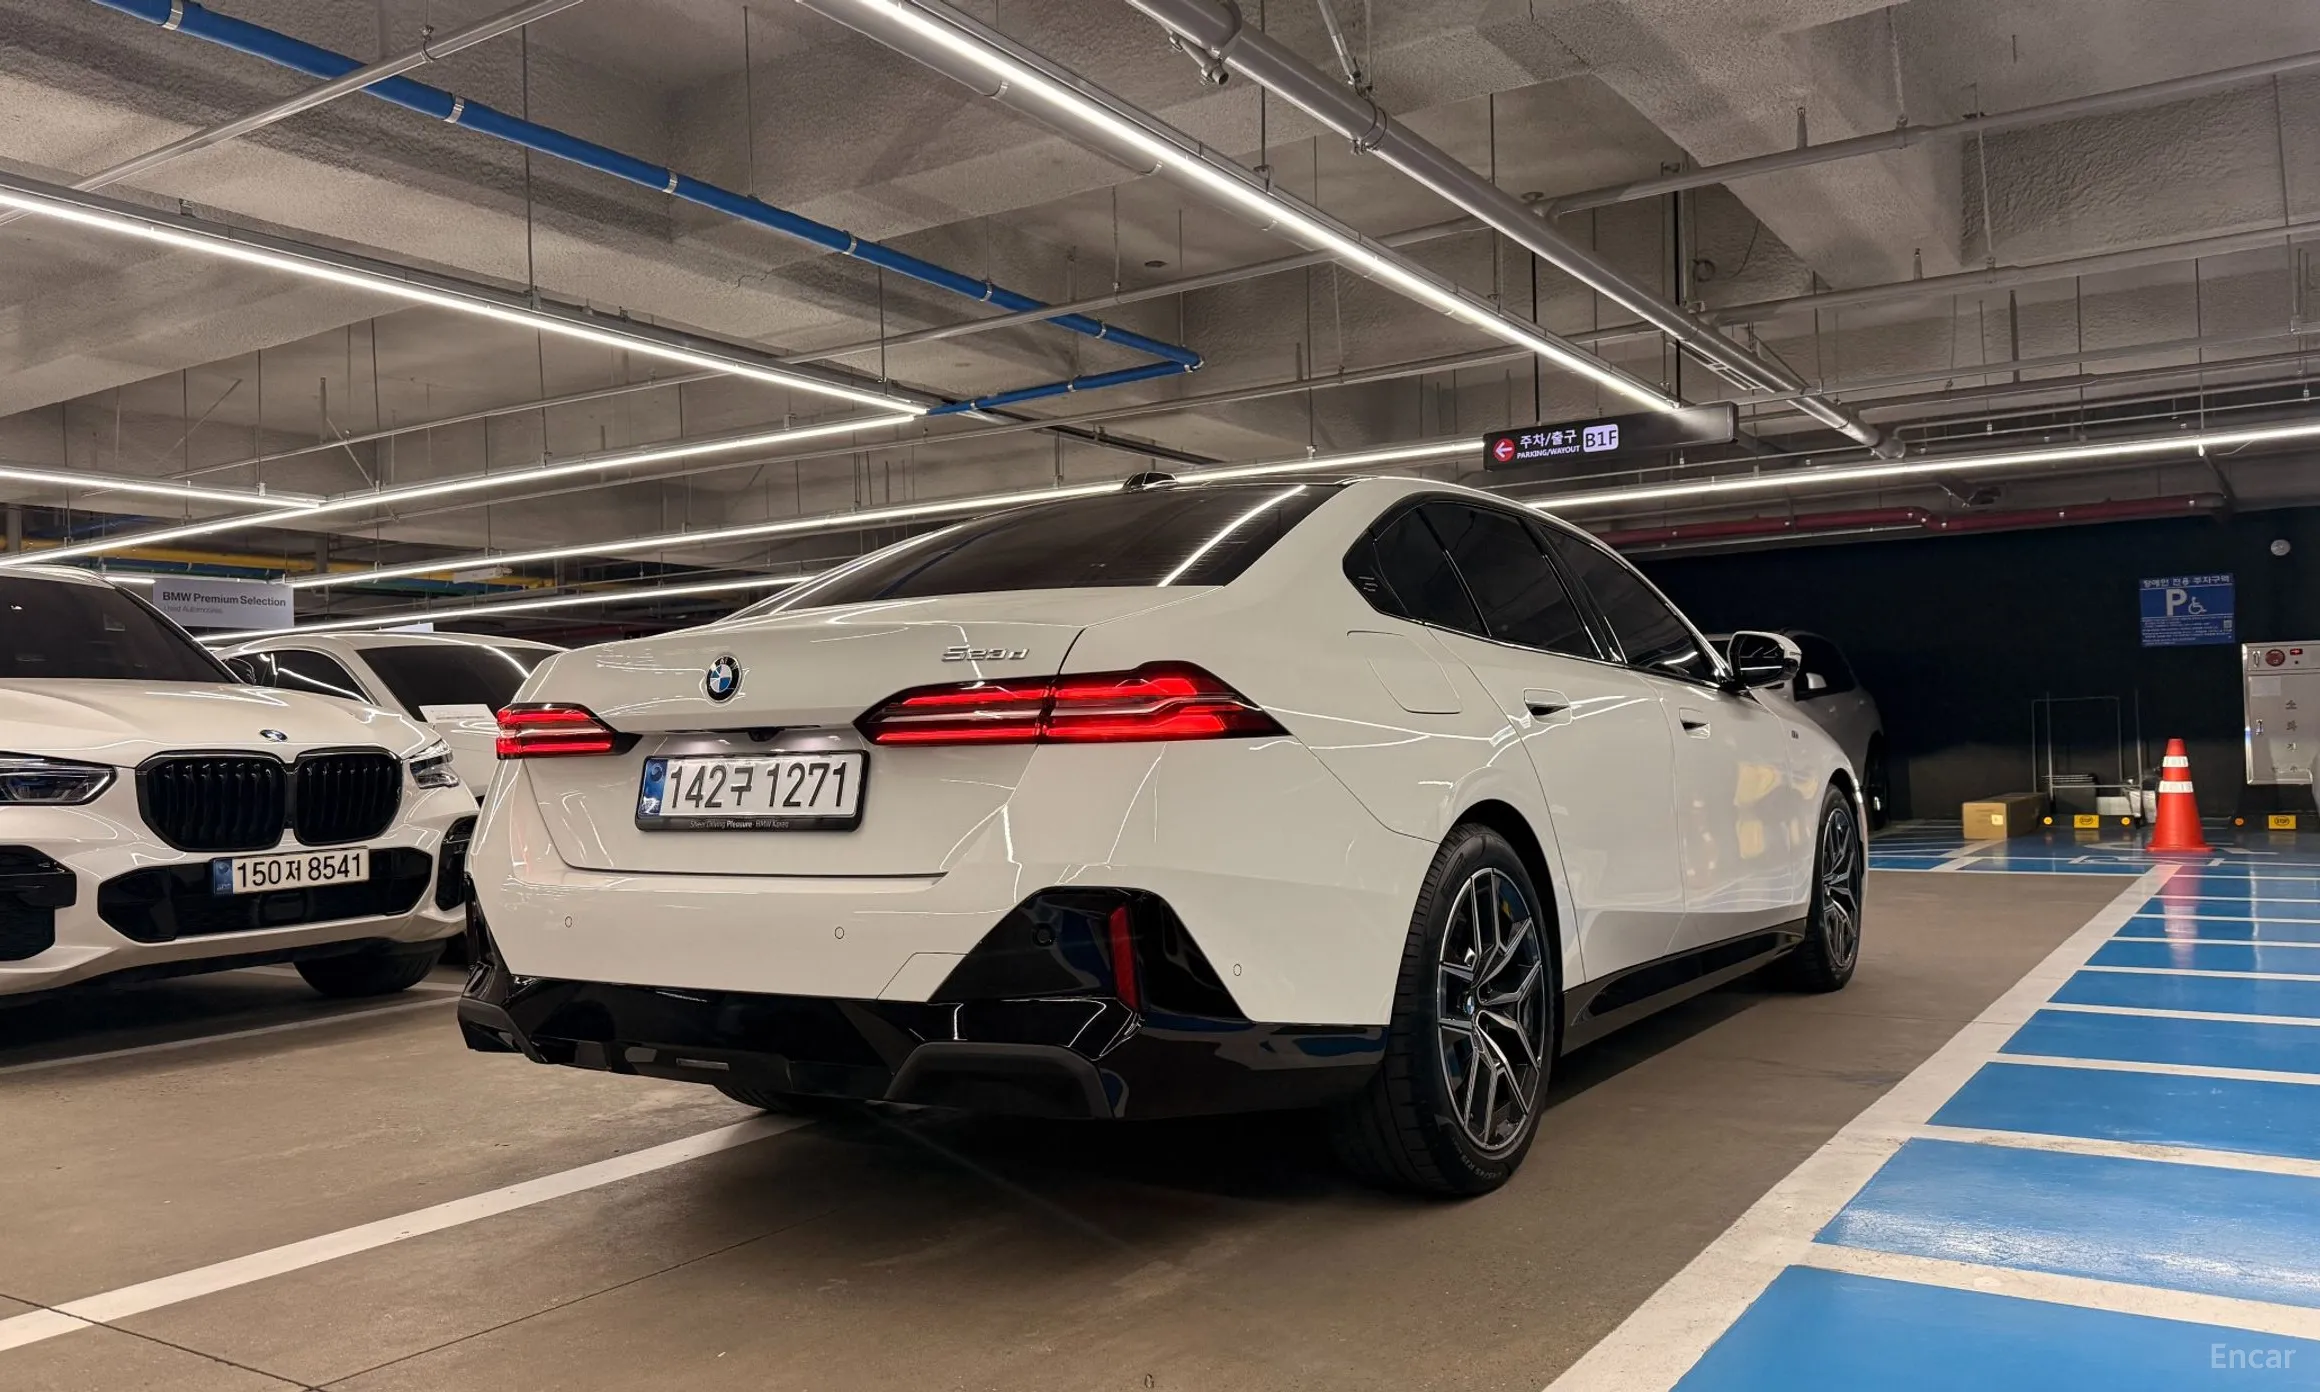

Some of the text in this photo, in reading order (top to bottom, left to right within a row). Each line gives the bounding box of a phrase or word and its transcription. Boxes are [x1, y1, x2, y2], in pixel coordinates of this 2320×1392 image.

[1520, 429, 1577, 449] 주차/출구
[1585, 429, 1617, 447] B1F
[1516, 445, 1581, 459] PARKING/WAYOUT
[162, 591, 286, 607] BMW Premium Selection
[2166, 588, 2187, 617] P
[670, 761, 847, 809] 142구 1271
[237, 853, 360, 887] 150저 8541
